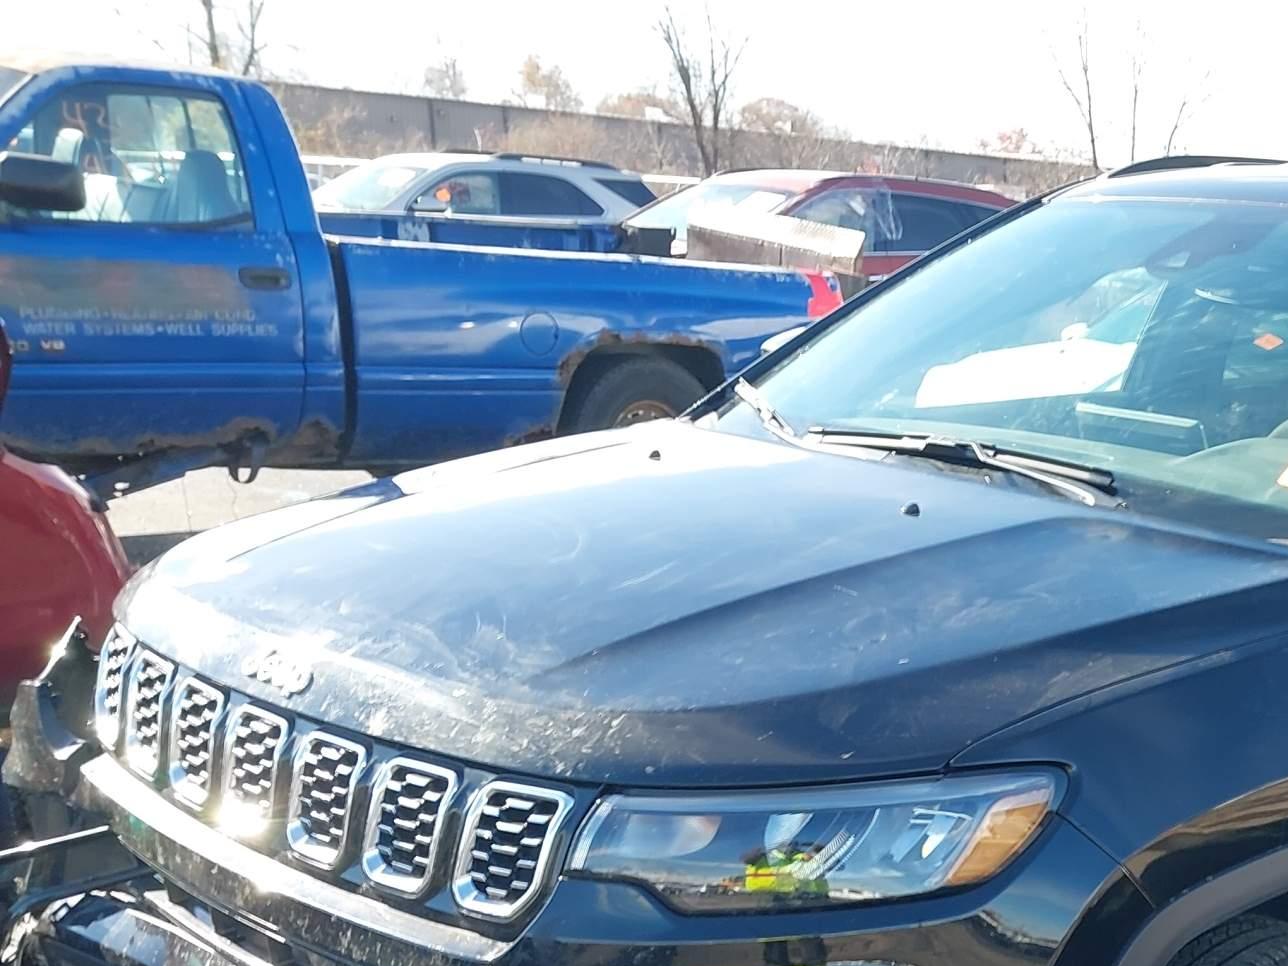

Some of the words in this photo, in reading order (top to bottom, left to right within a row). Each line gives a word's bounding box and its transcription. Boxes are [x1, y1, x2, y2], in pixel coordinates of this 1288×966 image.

[23, 321, 77, 336] WATER
[211, 322, 279, 336] SUPPLIES
[240, 649, 314, 699] Jeep
